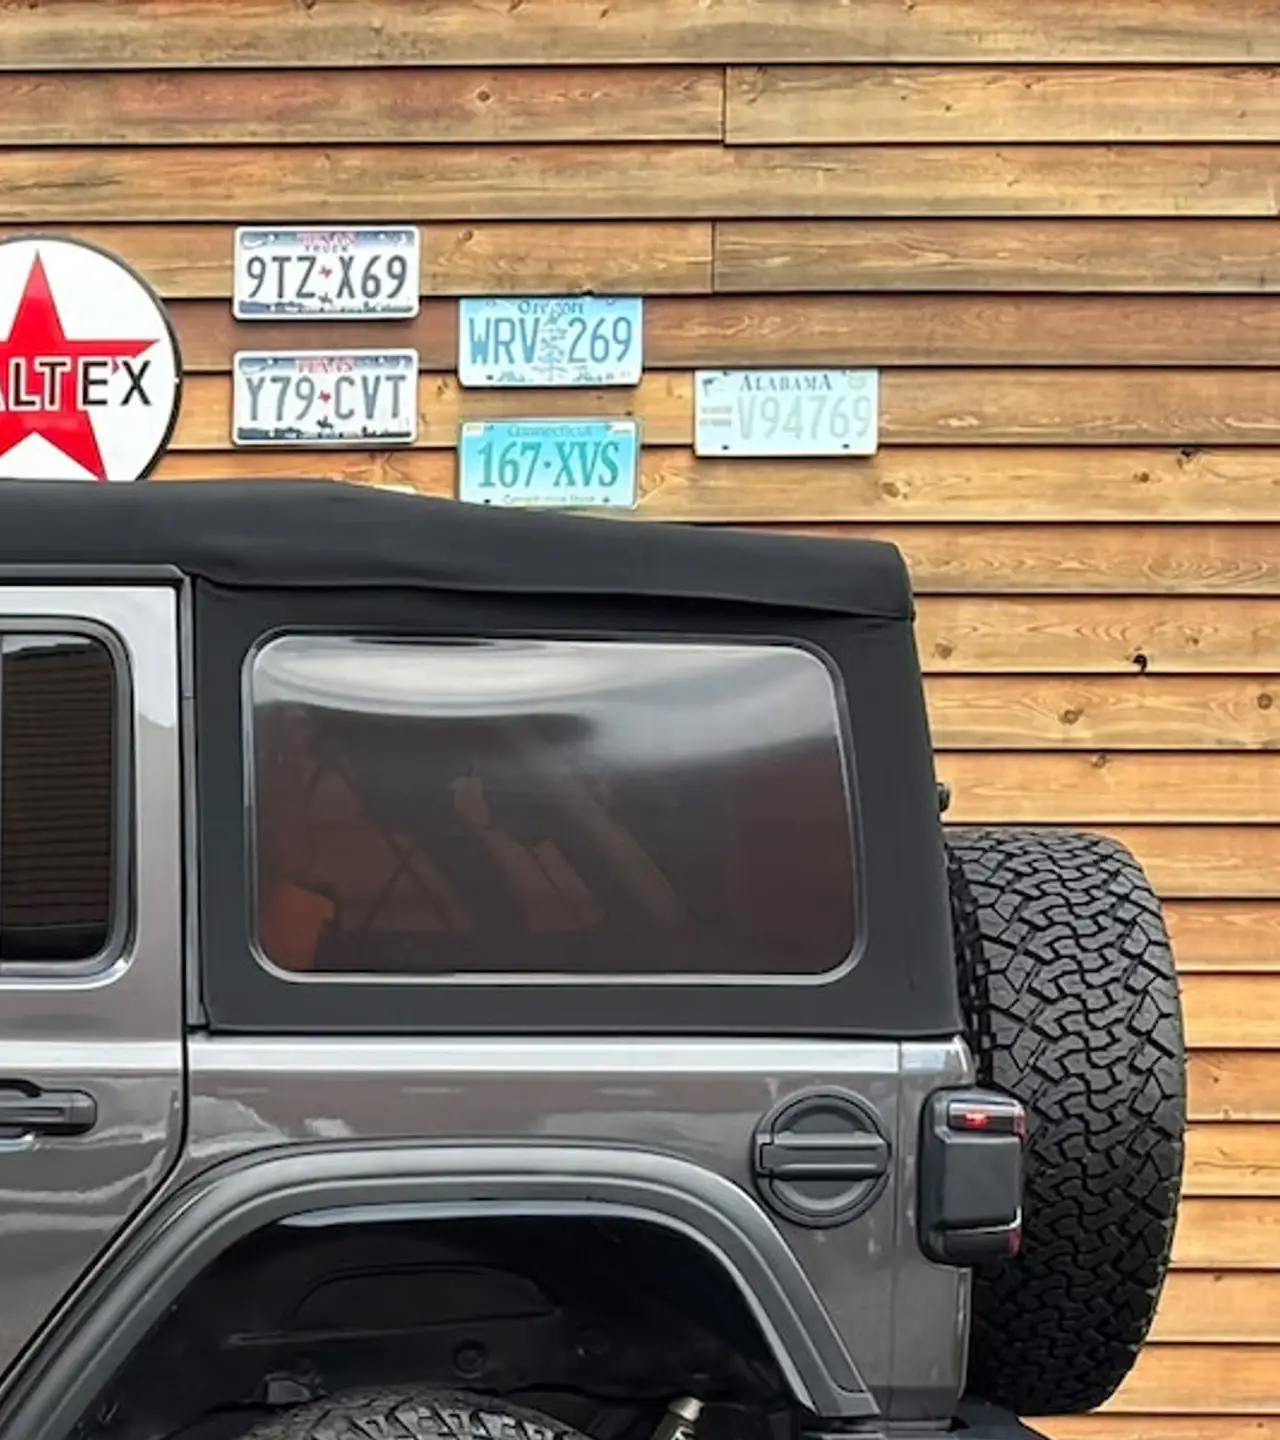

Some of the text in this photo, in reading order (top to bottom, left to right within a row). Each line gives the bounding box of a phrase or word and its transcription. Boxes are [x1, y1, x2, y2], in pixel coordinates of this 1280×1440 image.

[517, 300, 584, 318] Oregon
[469, 316, 632, 365] WRV 269
[740, 374, 833, 392] ALABAMA
[736, 394, 872, 441] V94769
